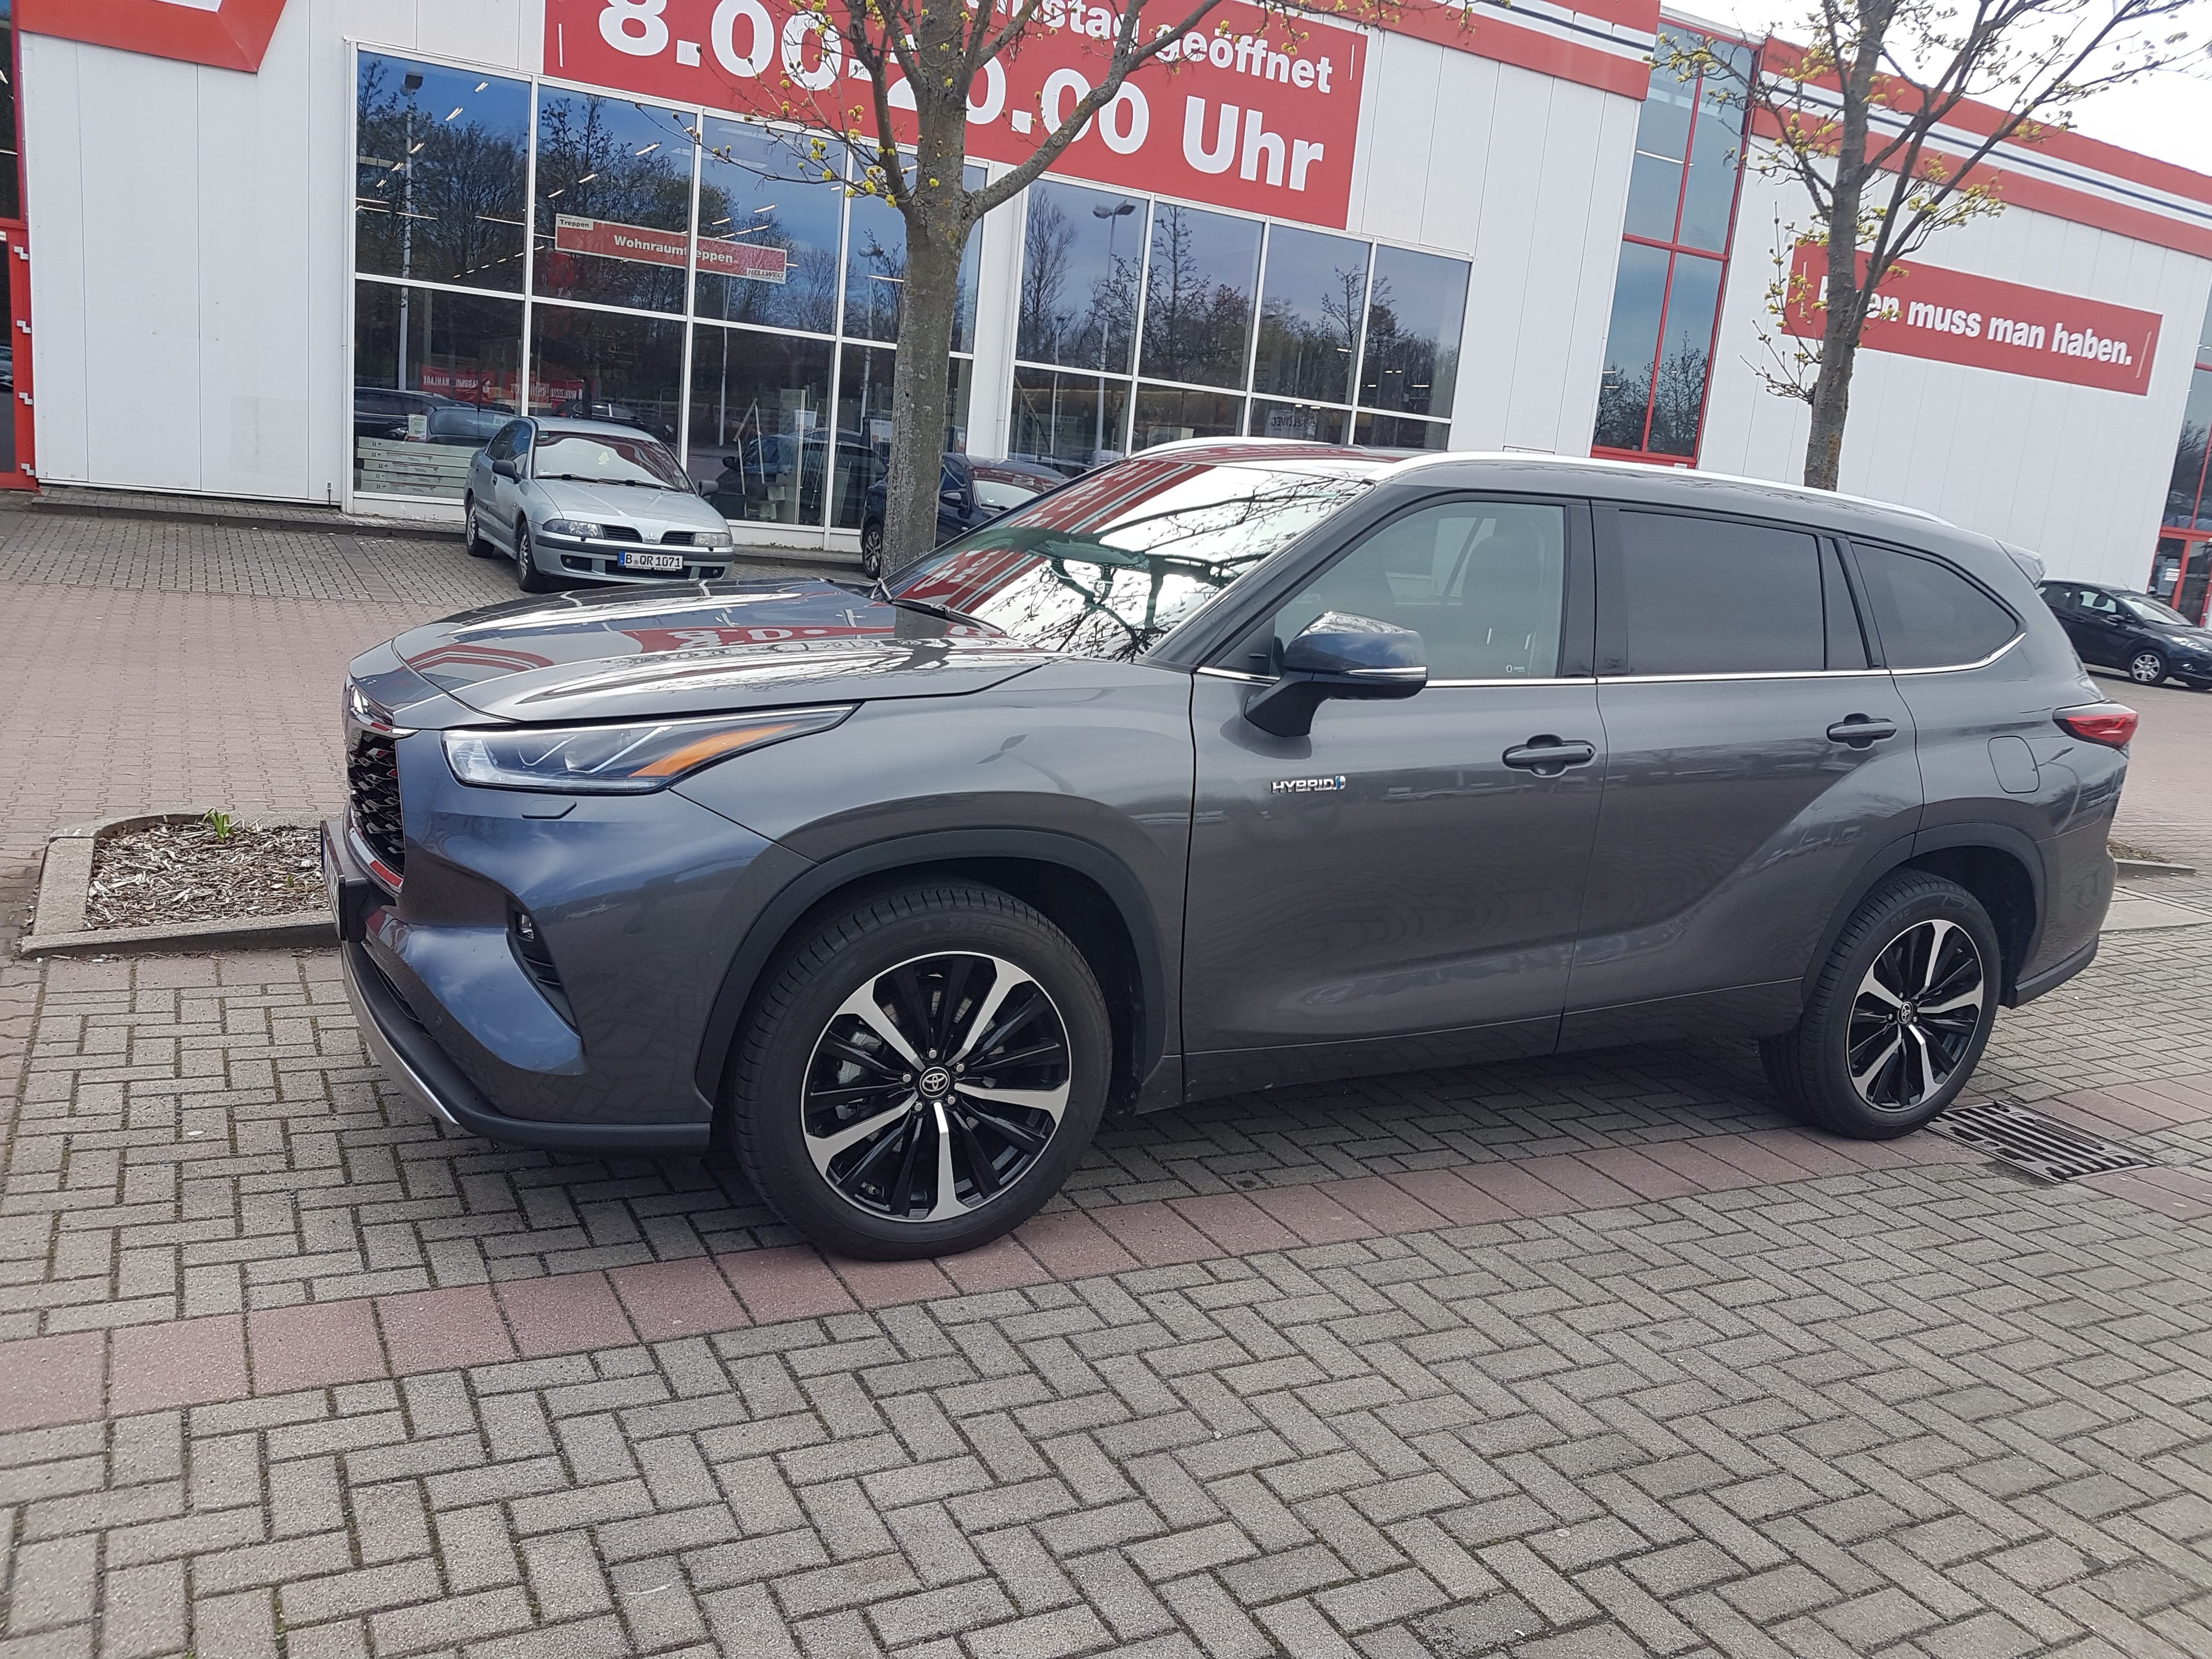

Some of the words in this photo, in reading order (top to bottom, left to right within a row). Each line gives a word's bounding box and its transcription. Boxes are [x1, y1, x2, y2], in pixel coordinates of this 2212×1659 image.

[1155, 24, 1333, 94] geöffnet
[1183, 95, 1324, 191] Uhr
[560, 219, 590, 229] Treppen
[614, 235, 733, 263] Wohnraumteppen
[1907, 300, 1982, 337] muss
[1987, 316, 2045, 349] man
[2051, 323, 2134, 366] haben.
[625, 554, 633, 564] B
[640, 555, 653, 566] QR
[655, 557, 681, 567] 1071
[1271, 778, 1335, 794] HYBRID
